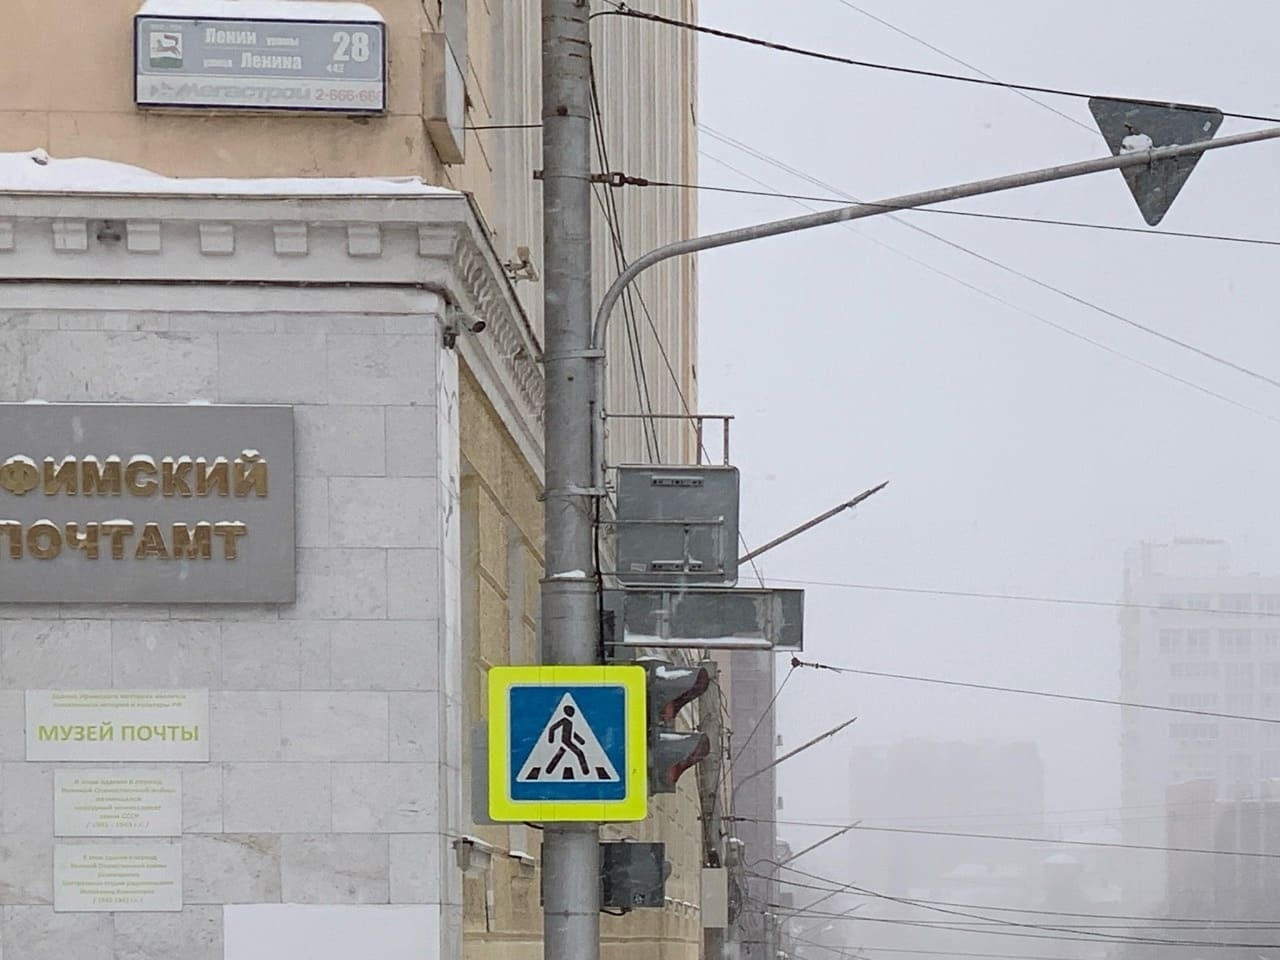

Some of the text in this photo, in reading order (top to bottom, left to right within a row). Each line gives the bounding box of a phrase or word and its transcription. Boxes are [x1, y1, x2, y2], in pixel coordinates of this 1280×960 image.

[205, 28, 257, 45] Ленин
[333, 31, 370, 62] 28
[241, 52, 302, 70] Ленина
[0, 519, 249, 561] ПОЧТАМТ
[38, 721, 199, 742] МУЗЕЙ ПОЧТЫ
